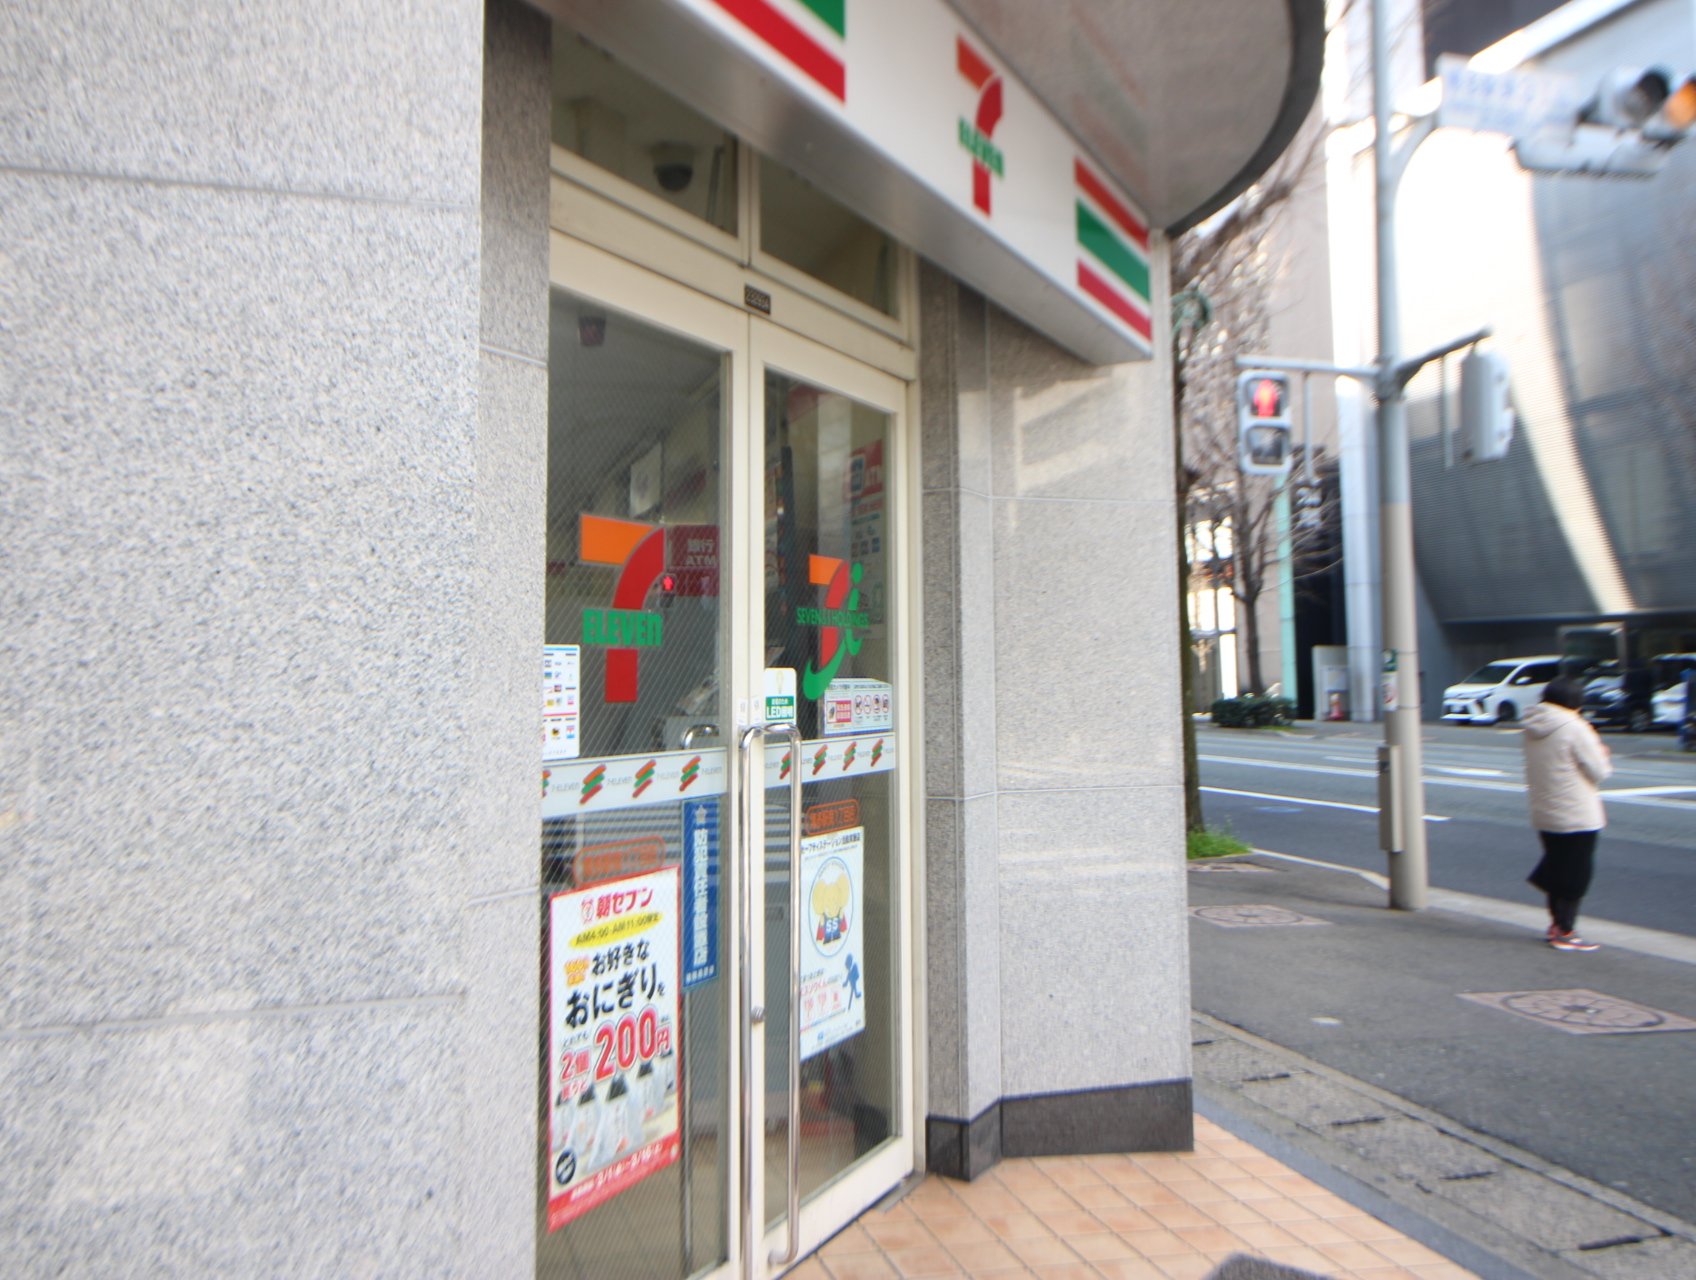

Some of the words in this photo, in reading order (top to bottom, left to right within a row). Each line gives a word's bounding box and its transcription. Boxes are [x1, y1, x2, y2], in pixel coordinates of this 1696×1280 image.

[957, 35, 1003, 218] 7
[580, 514, 665, 702] 7
[687, 555, 716, 567] ATM
[592, 938, 651, 976] お好きな
